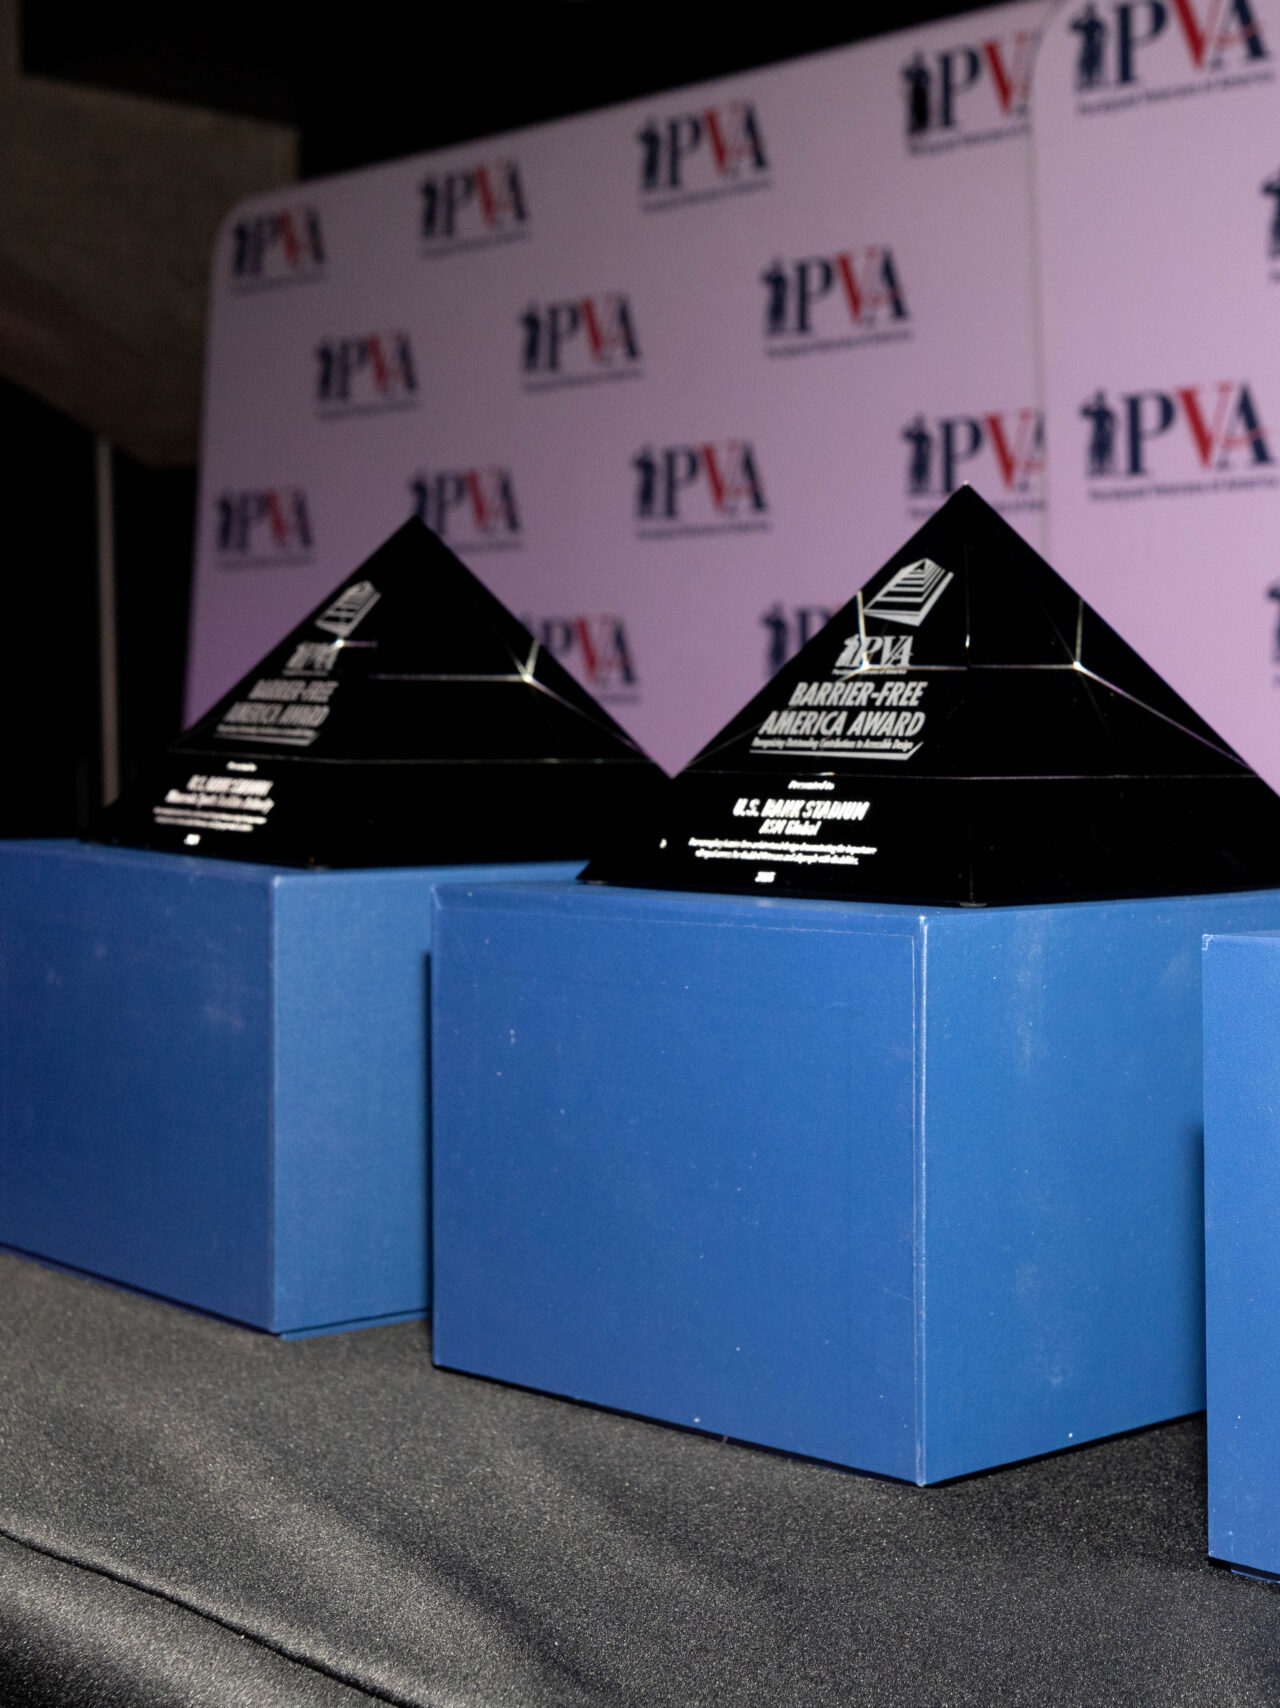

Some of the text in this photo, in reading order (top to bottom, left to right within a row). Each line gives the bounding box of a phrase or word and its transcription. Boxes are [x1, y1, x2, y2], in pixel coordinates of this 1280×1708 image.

[936, 30, 1031, 128] PV
[1116, 0, 1271, 86] PVA
[792, 246, 909, 335] PVA
[1119, 381, 1278, 478] PVA
[758, 711, 926, 737] AMERICA AWARD
[788, 682, 928, 707] BARRIER-FREE
